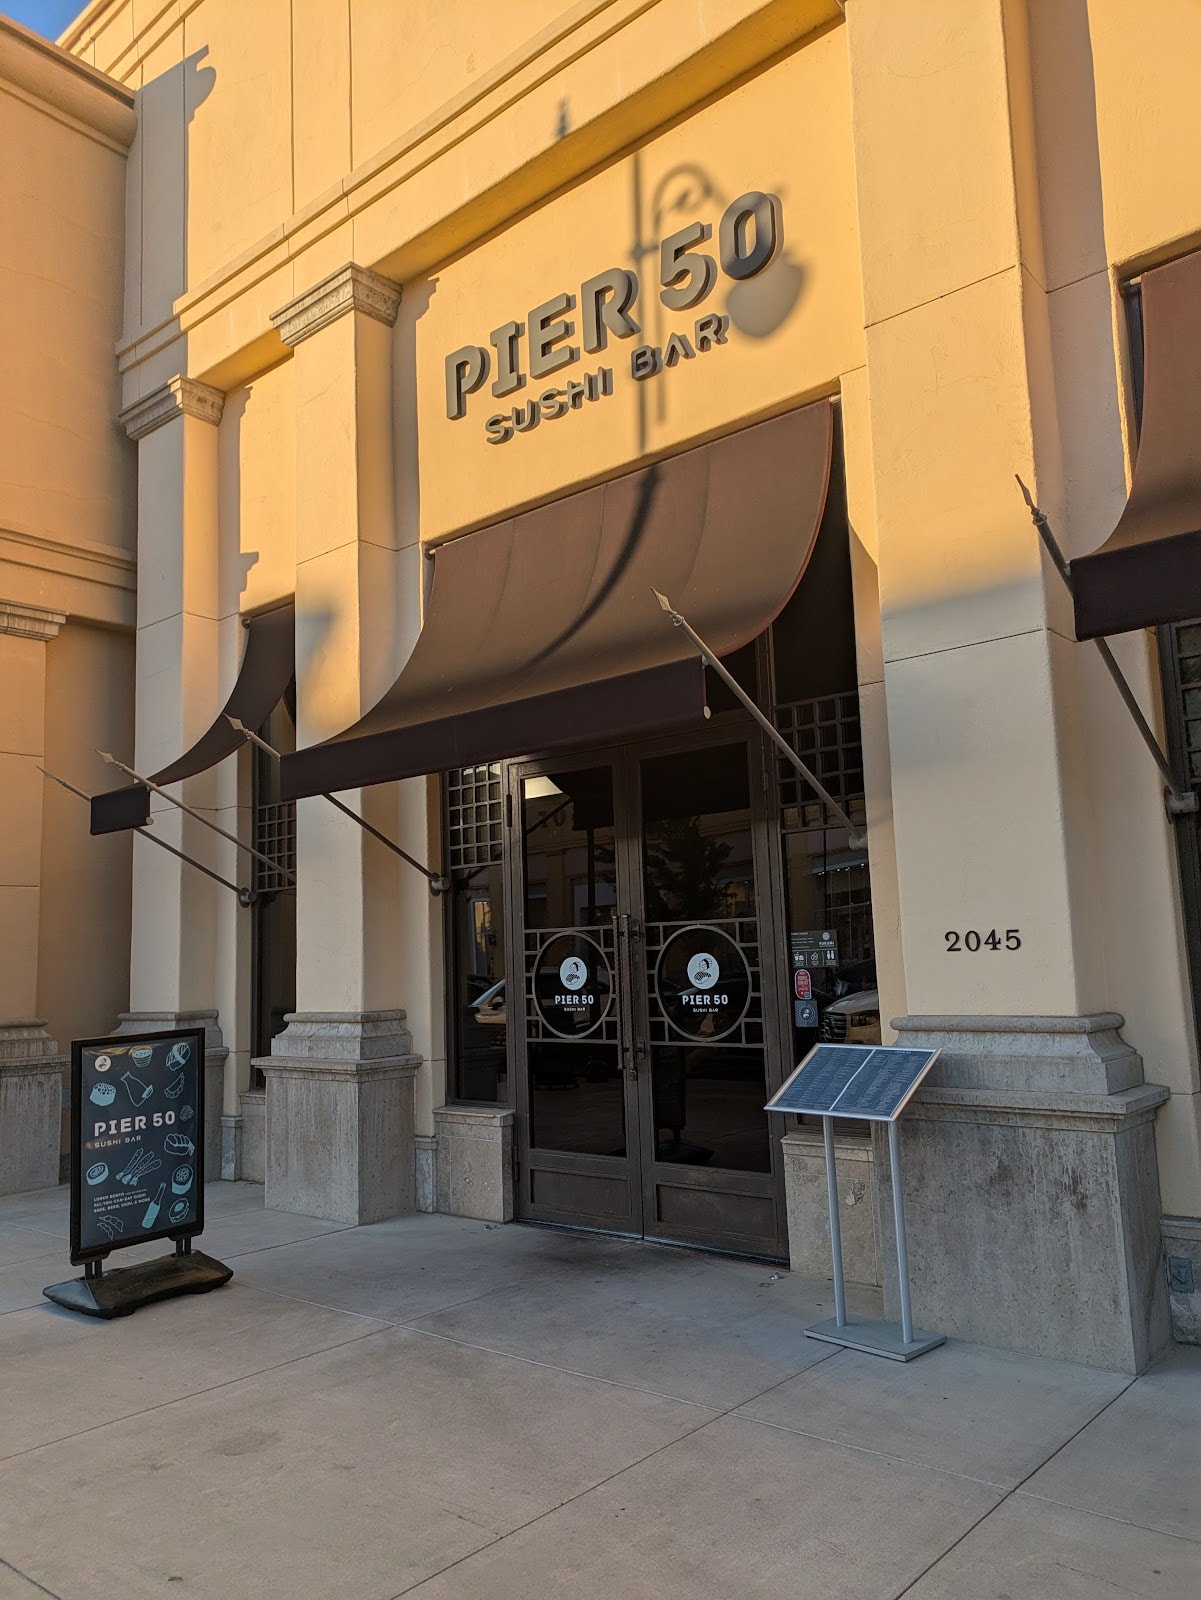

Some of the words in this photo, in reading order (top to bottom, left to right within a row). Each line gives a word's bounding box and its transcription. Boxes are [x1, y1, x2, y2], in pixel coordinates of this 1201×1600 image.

[445, 268, 641, 421] PIER
[659, 191, 784, 311] 50
[485, 367, 613, 445] SUSHI
[631, 313, 730, 381] BAR
[944, 929, 1022, 952] 2045
[555, 995, 579, 1005] PIER
[581, 995, 594, 1005] 50
[682, 995, 711, 1005] PIER
[713, 994, 729, 1005] 50
[94, 1115, 147, 1137] PIER
[152, 1110, 176, 1128] 50
[94, 1139, 122, 1149] SUSHI
[124, 1135, 142, 1144] BAR
